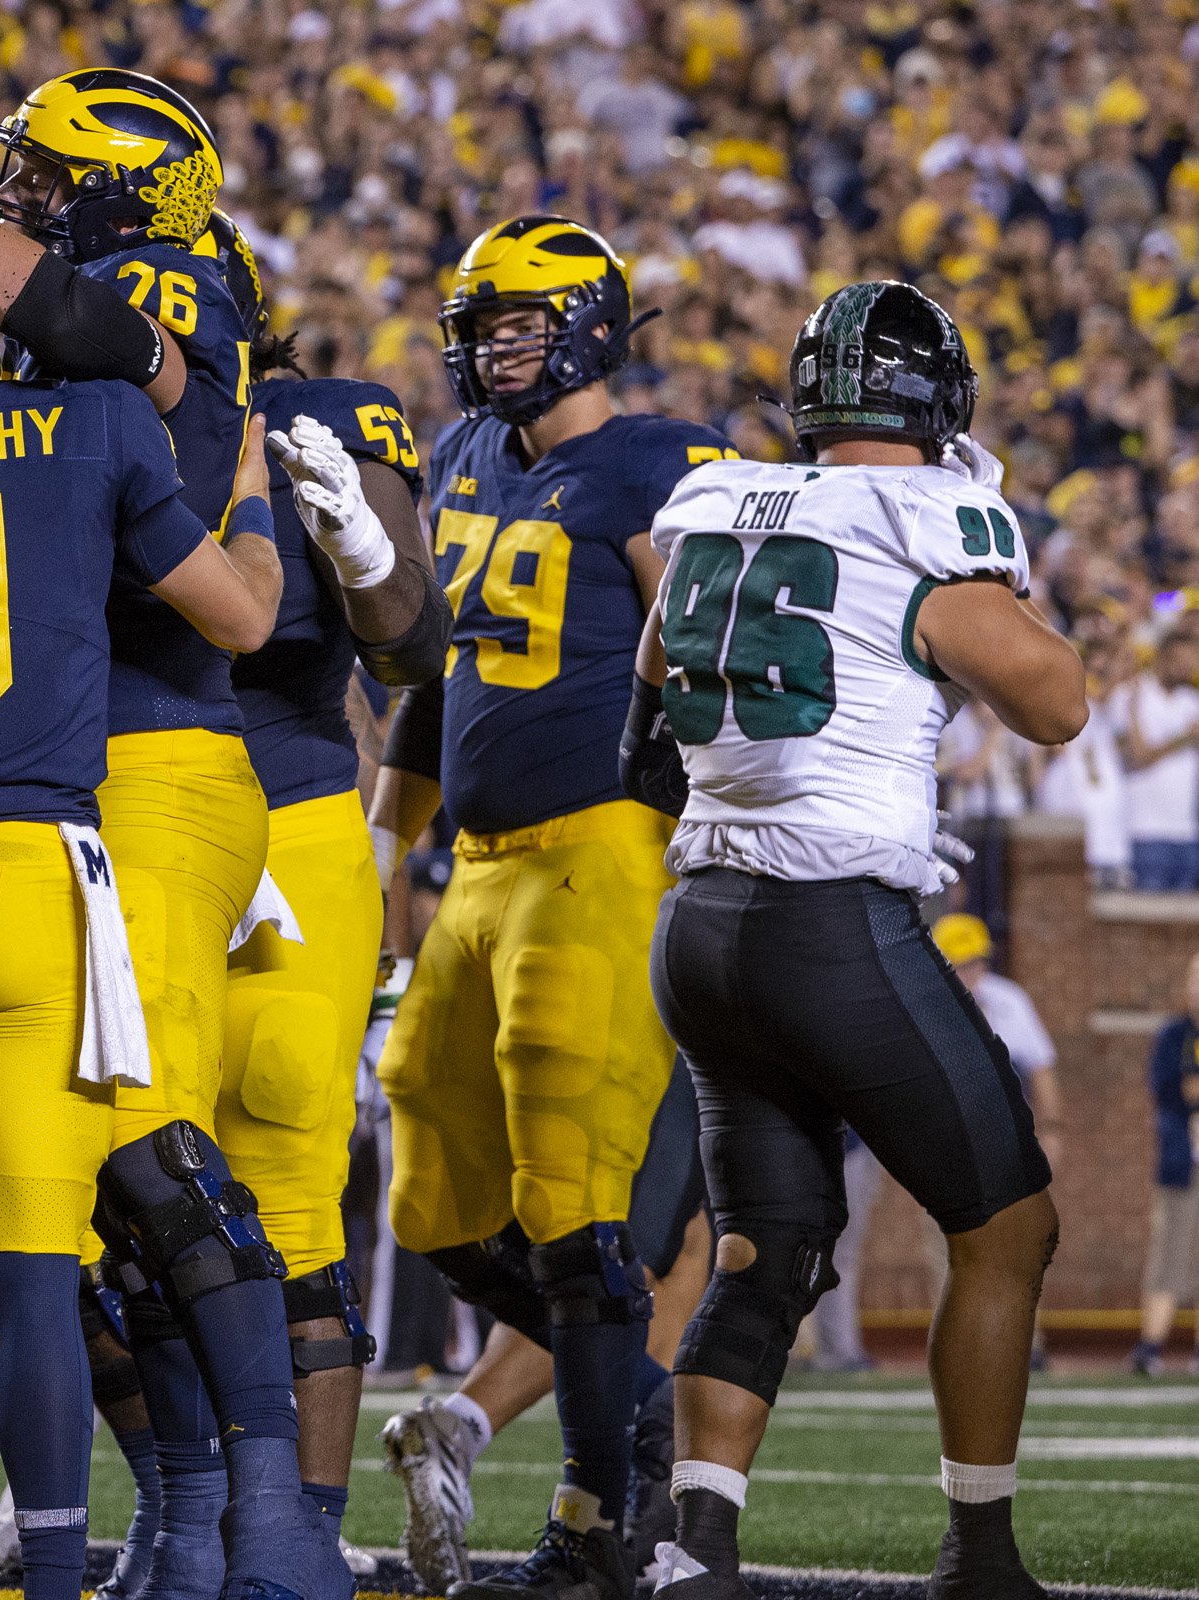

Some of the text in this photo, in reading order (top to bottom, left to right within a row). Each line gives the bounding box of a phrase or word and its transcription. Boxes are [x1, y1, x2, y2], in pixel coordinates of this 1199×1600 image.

[117, 261, 197, 336] 76
[821, 342, 864, 369] 96
[355, 403, 419, 468] 53
[732, 490, 800, 530] CHOI
[956, 505, 1015, 558] 96
[435, 507, 573, 690] 79
[660, 533, 839, 746] 96
[77, 840, 111, 888] M
